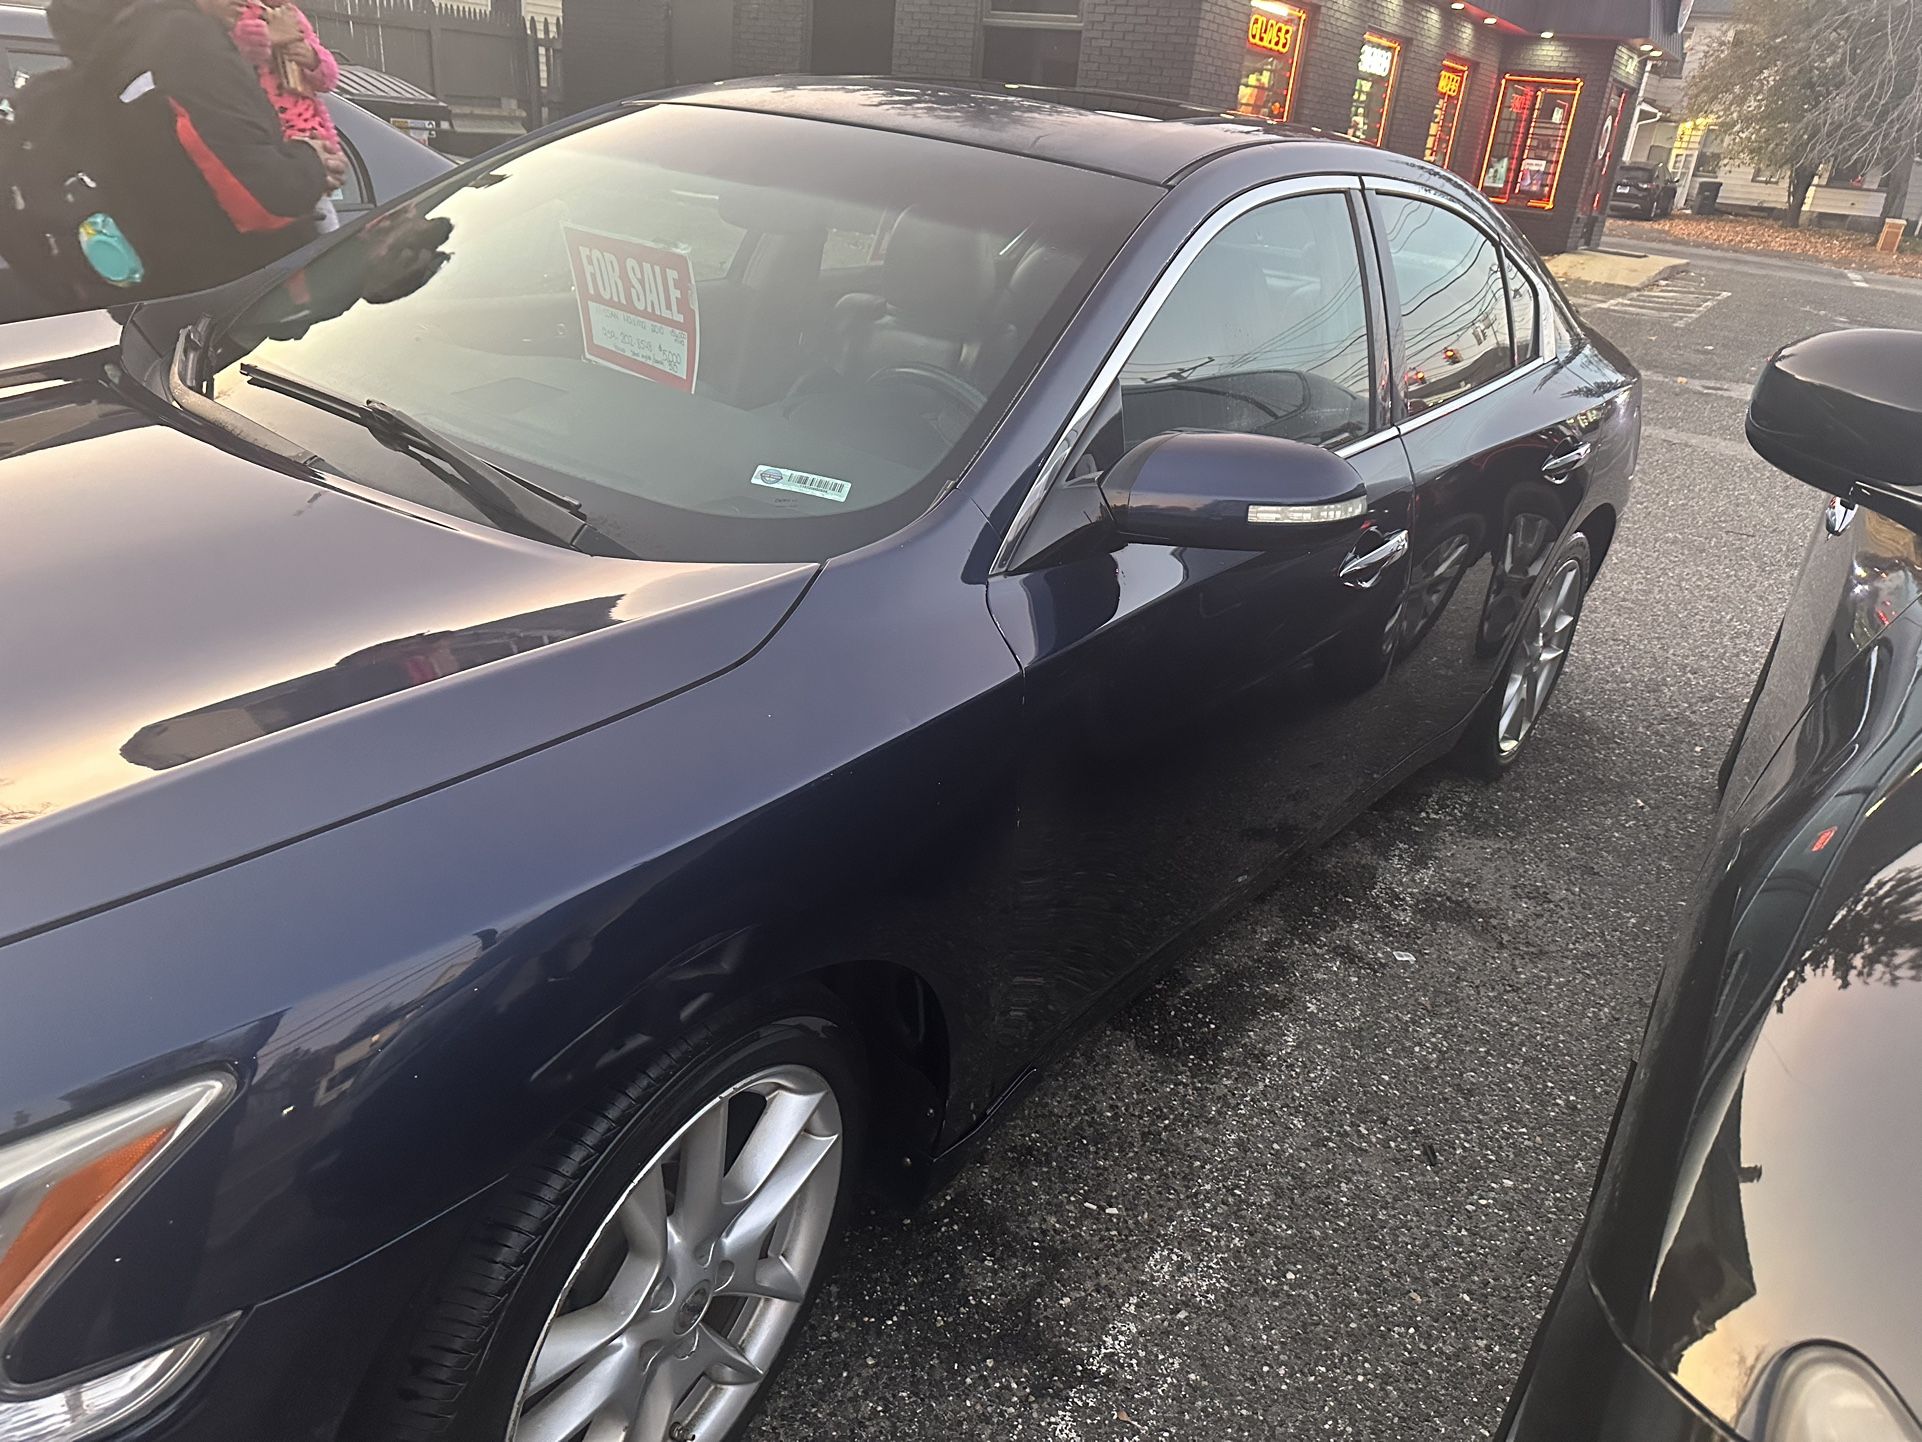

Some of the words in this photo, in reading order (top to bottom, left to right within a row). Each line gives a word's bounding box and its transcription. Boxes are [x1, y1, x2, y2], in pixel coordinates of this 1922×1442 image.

[1248, 13, 1293, 54] GLASS
[578, 246, 626, 305] FOR
[625, 257, 684, 323] SALE
